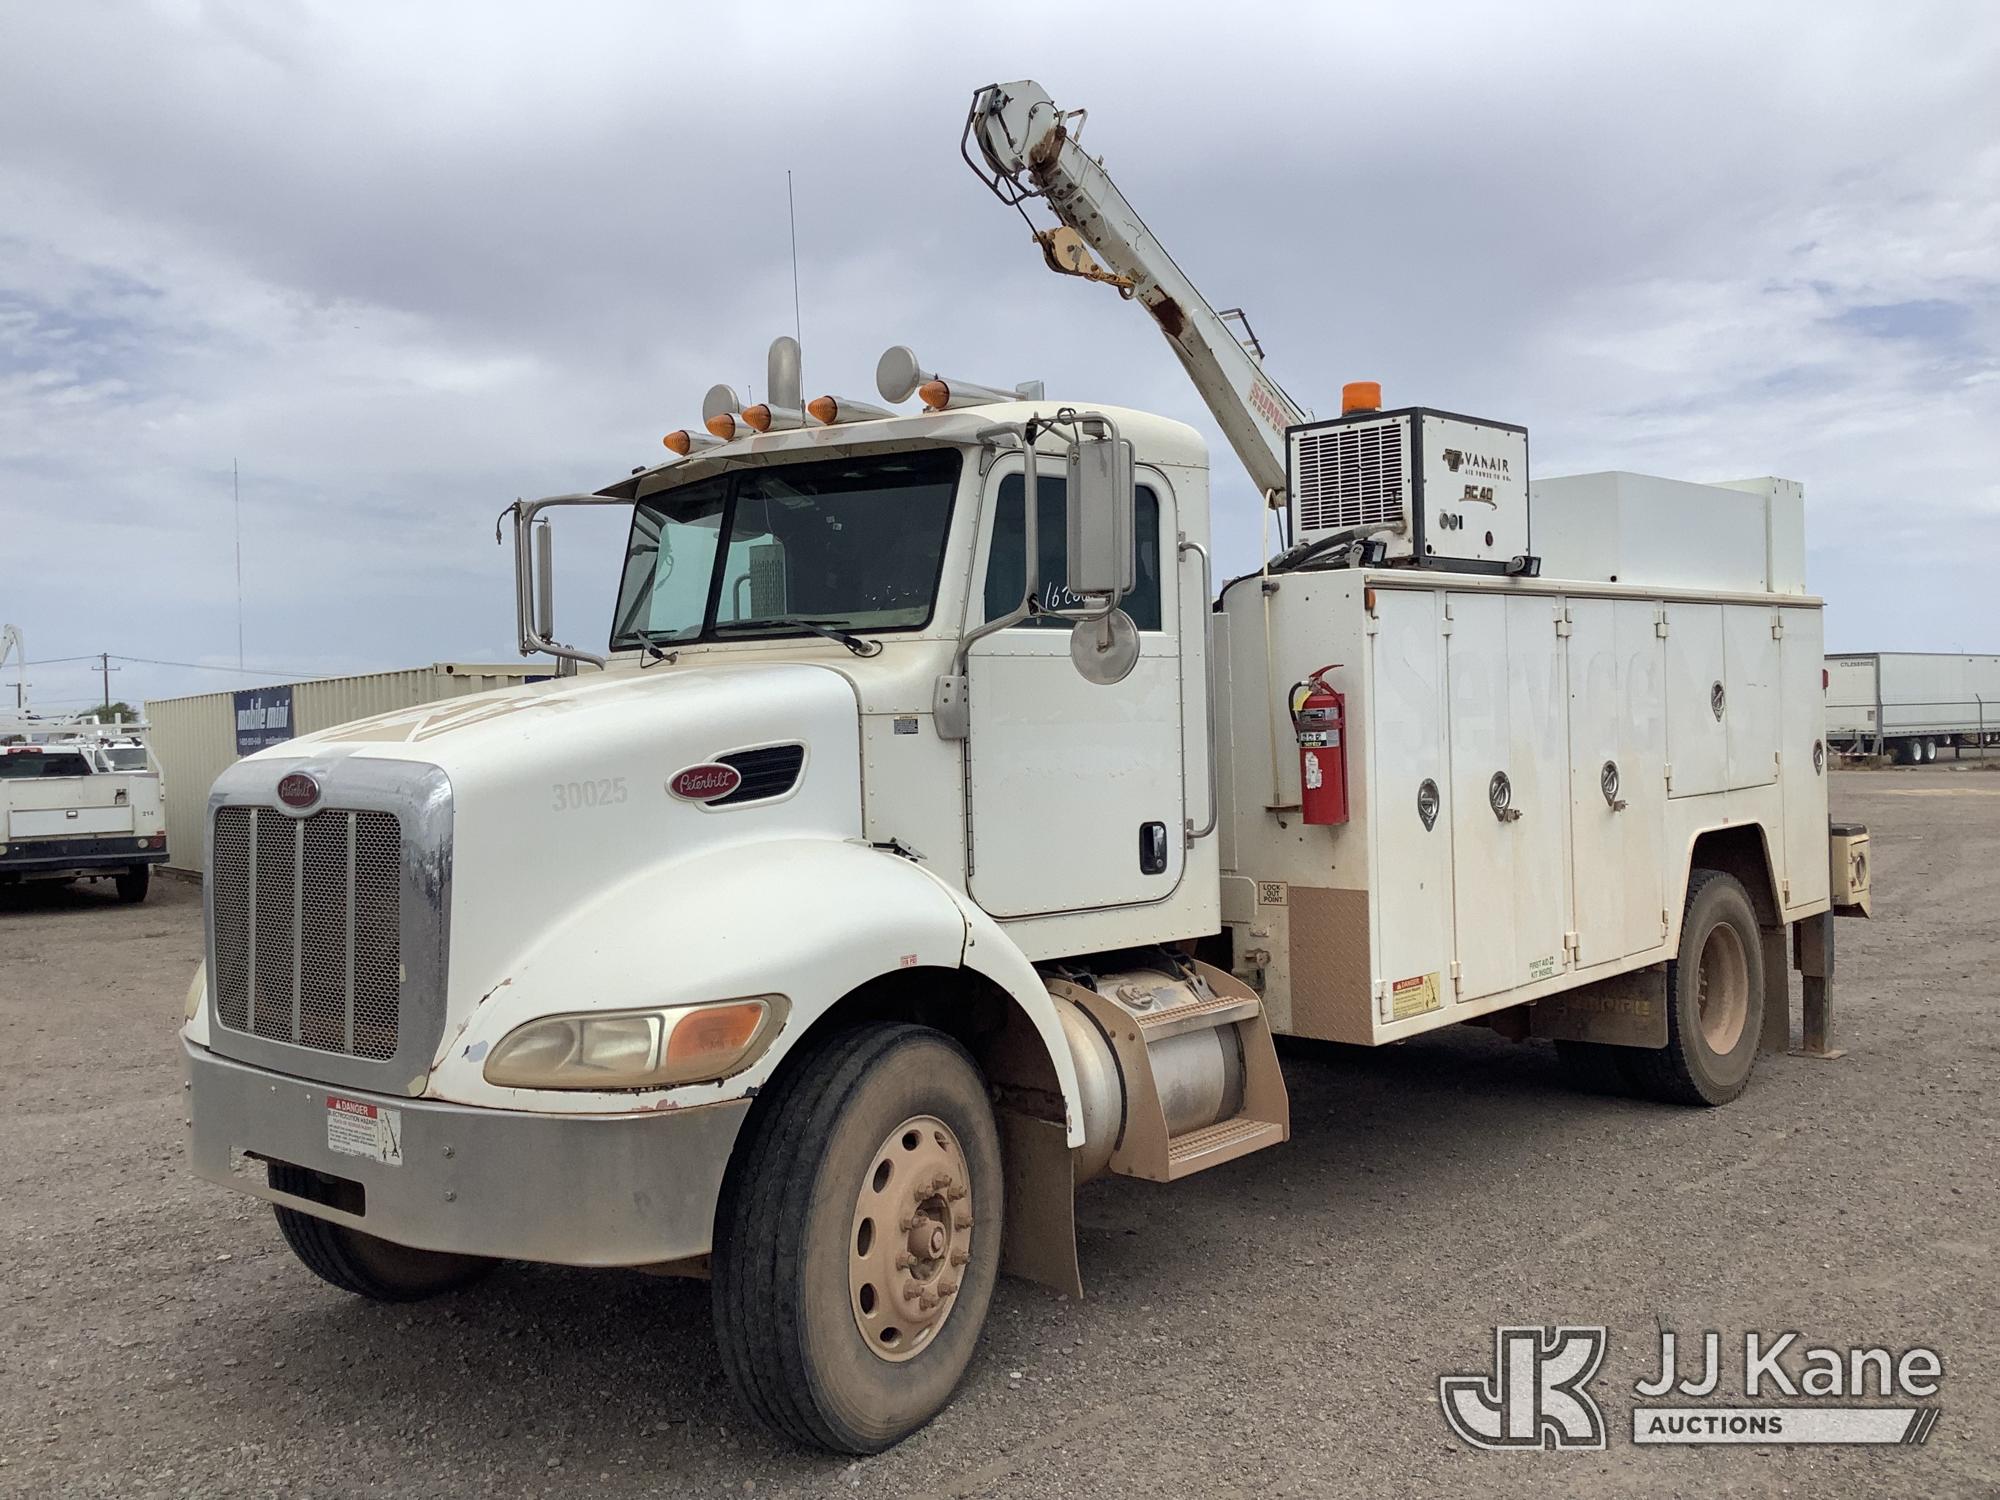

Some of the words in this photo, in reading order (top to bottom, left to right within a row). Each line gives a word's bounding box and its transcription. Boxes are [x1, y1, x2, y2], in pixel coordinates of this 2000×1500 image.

[1465, 452, 1508, 473] VANAIR
[237, 697, 266, 731] mobile
[266, 699, 289, 729] mini
[680, 771, 733, 793] Peterbilt
[552, 776, 628, 812] 30025
[1263, 883, 1284, 891] LOCK-
[341, 1100, 369, 1116] DANGER
